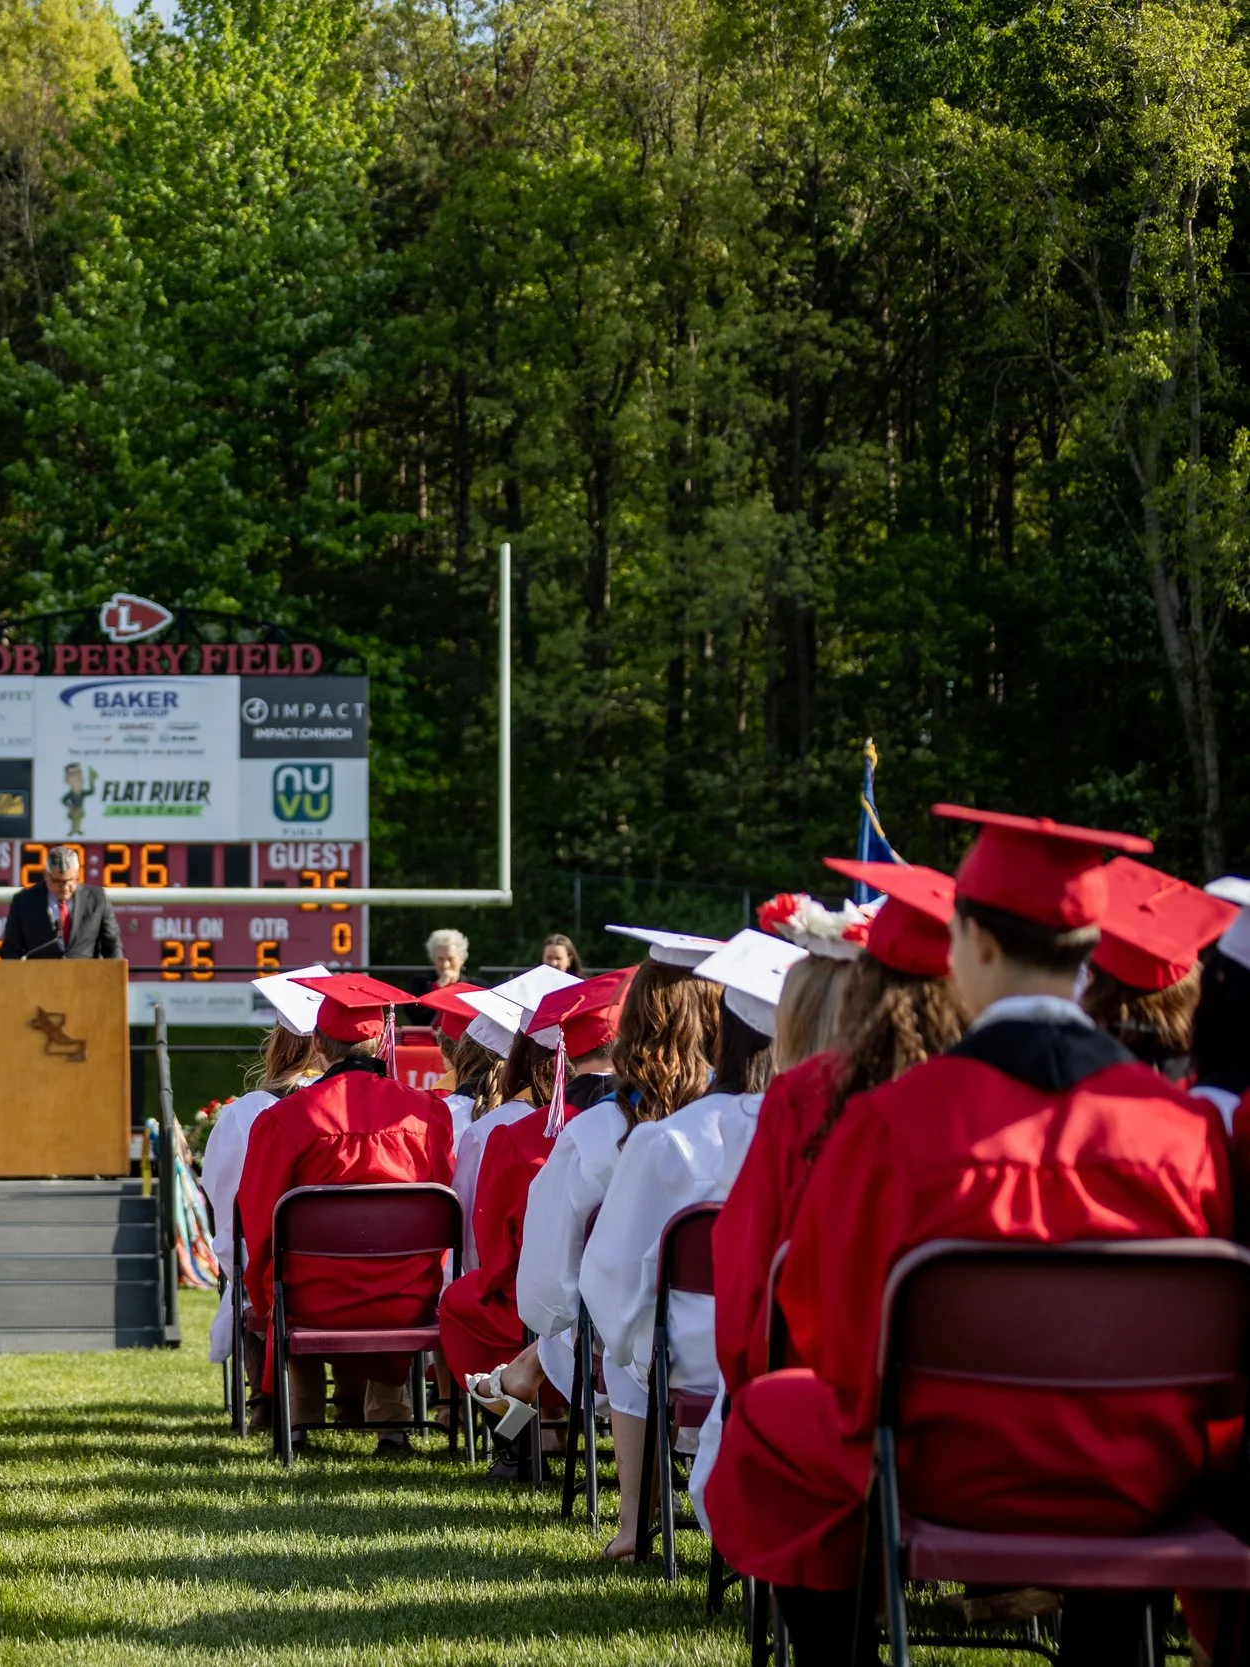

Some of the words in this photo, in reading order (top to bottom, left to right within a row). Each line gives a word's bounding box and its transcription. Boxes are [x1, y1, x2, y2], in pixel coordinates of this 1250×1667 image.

[53, 644, 189, 675] PERRY
[201, 644, 323, 675] FIELD
[94, 690, 179, 709] BAKER
[272, 702, 366, 720] IMPACT
[102, 780, 148, 802] FLAT
[149, 780, 212, 805] RIVER
[268, 842, 355, 870] GUEST
[152, 916, 196, 940] BALL
[197, 916, 224, 940] ON
[331, 922, 353, 956] 0
[160, 940, 215, 981] 26
